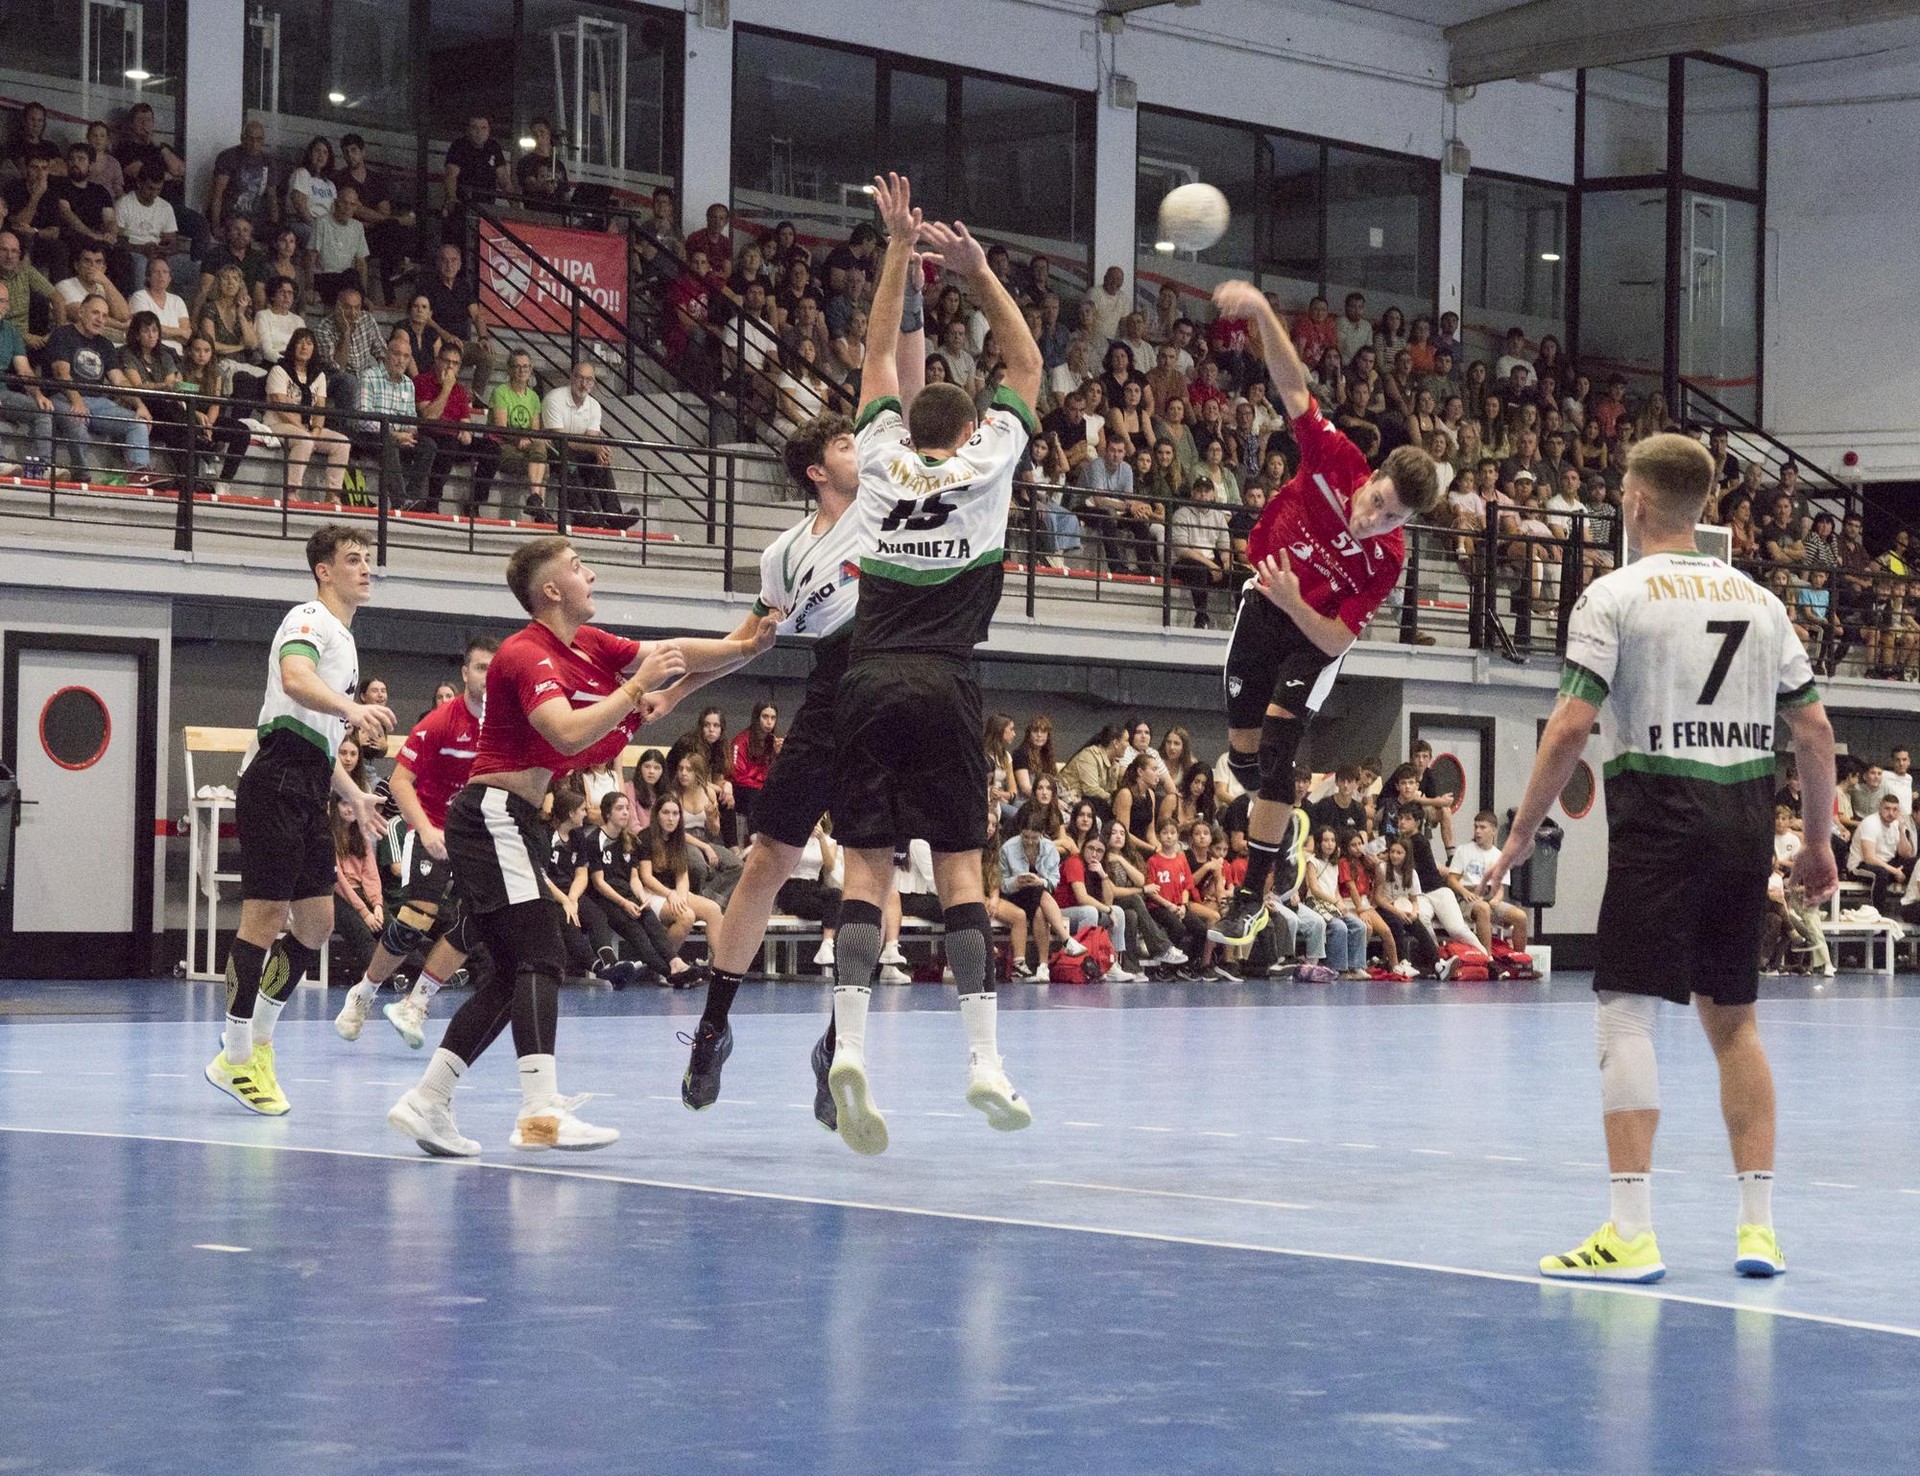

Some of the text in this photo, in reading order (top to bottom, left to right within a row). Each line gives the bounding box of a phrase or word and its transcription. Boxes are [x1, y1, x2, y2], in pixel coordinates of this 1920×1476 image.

[881, 485, 972, 531] 15
[1331, 531, 1364, 557] 57
[1696, 620, 1751, 706] 7
[1649, 721, 1774, 752] P. FERNANDE
